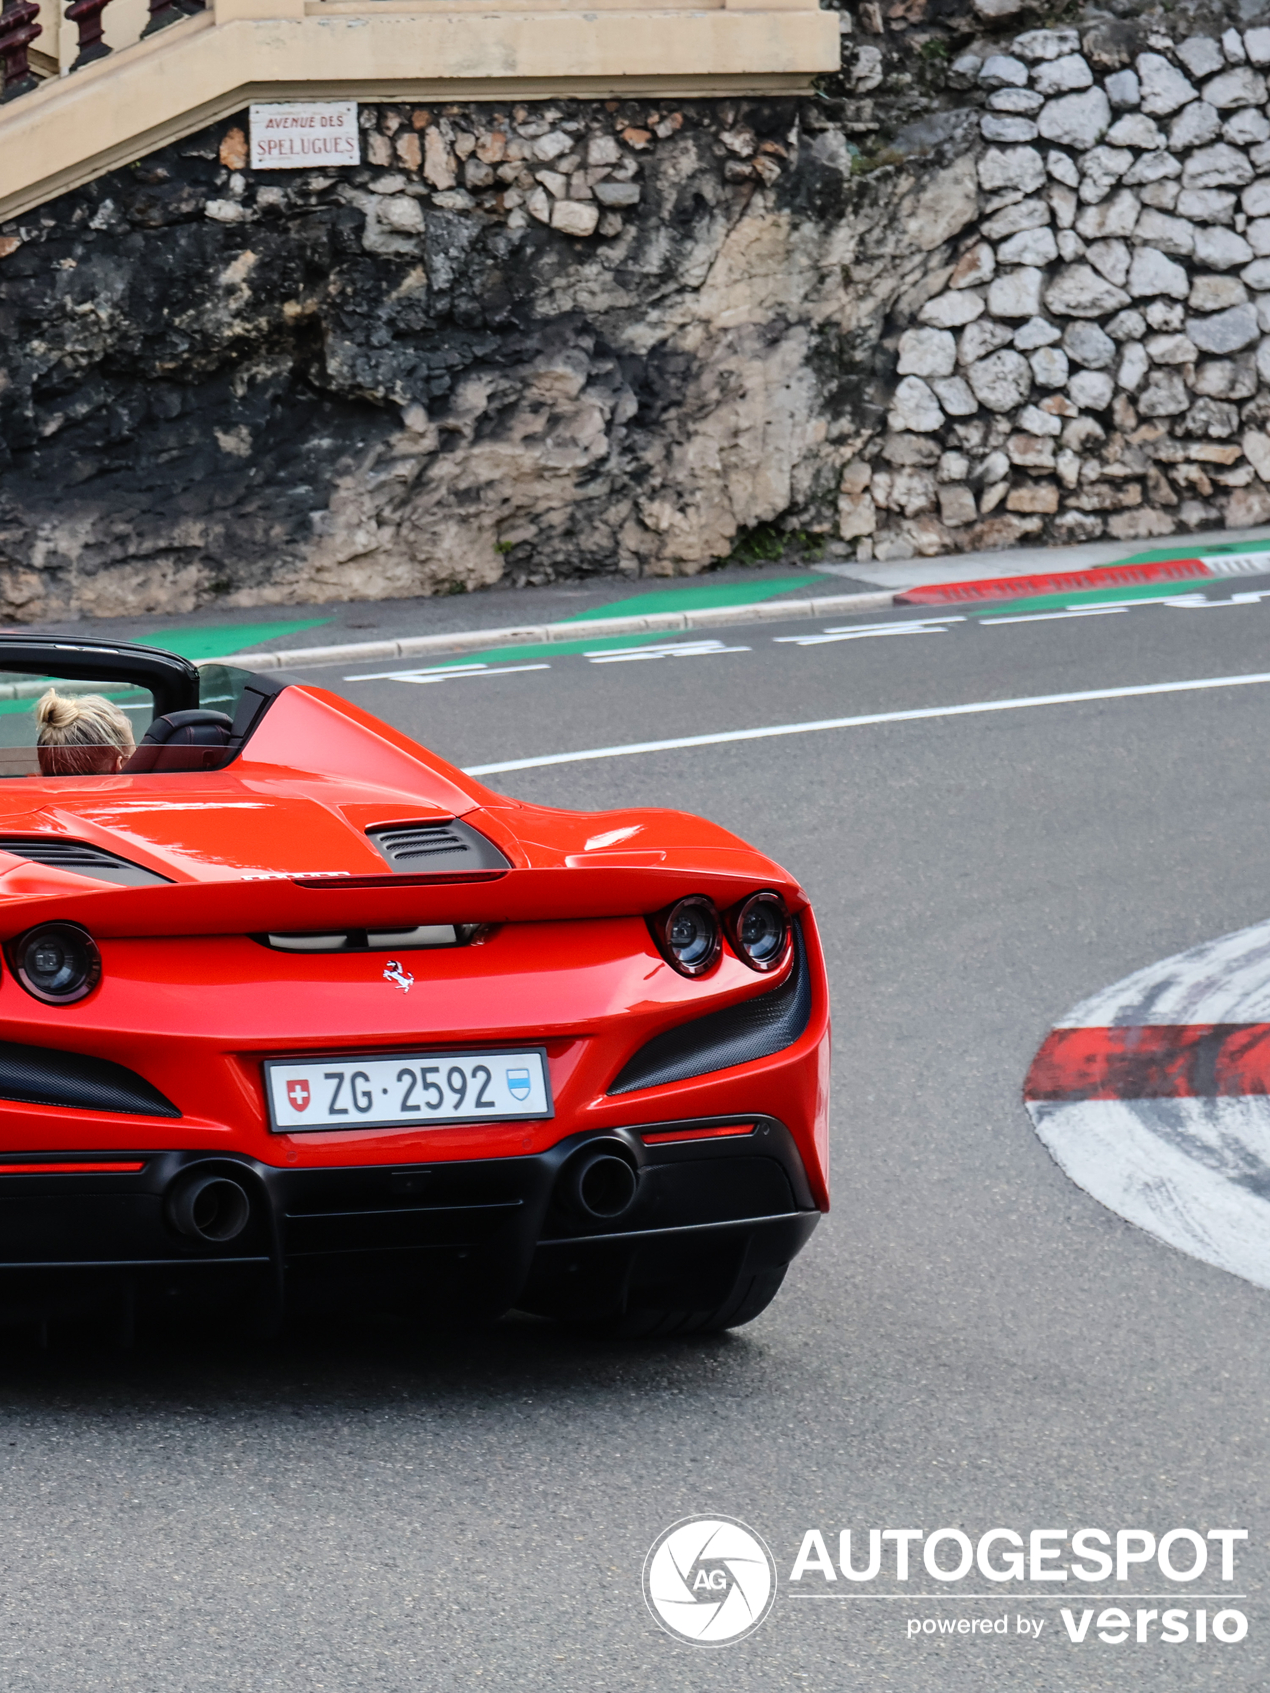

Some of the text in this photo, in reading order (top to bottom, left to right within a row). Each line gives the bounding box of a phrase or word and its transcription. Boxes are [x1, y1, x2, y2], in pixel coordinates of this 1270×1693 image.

[265, 115, 345, 129] AVENUE DES
[256, 136, 356, 156] SPELUGUES
